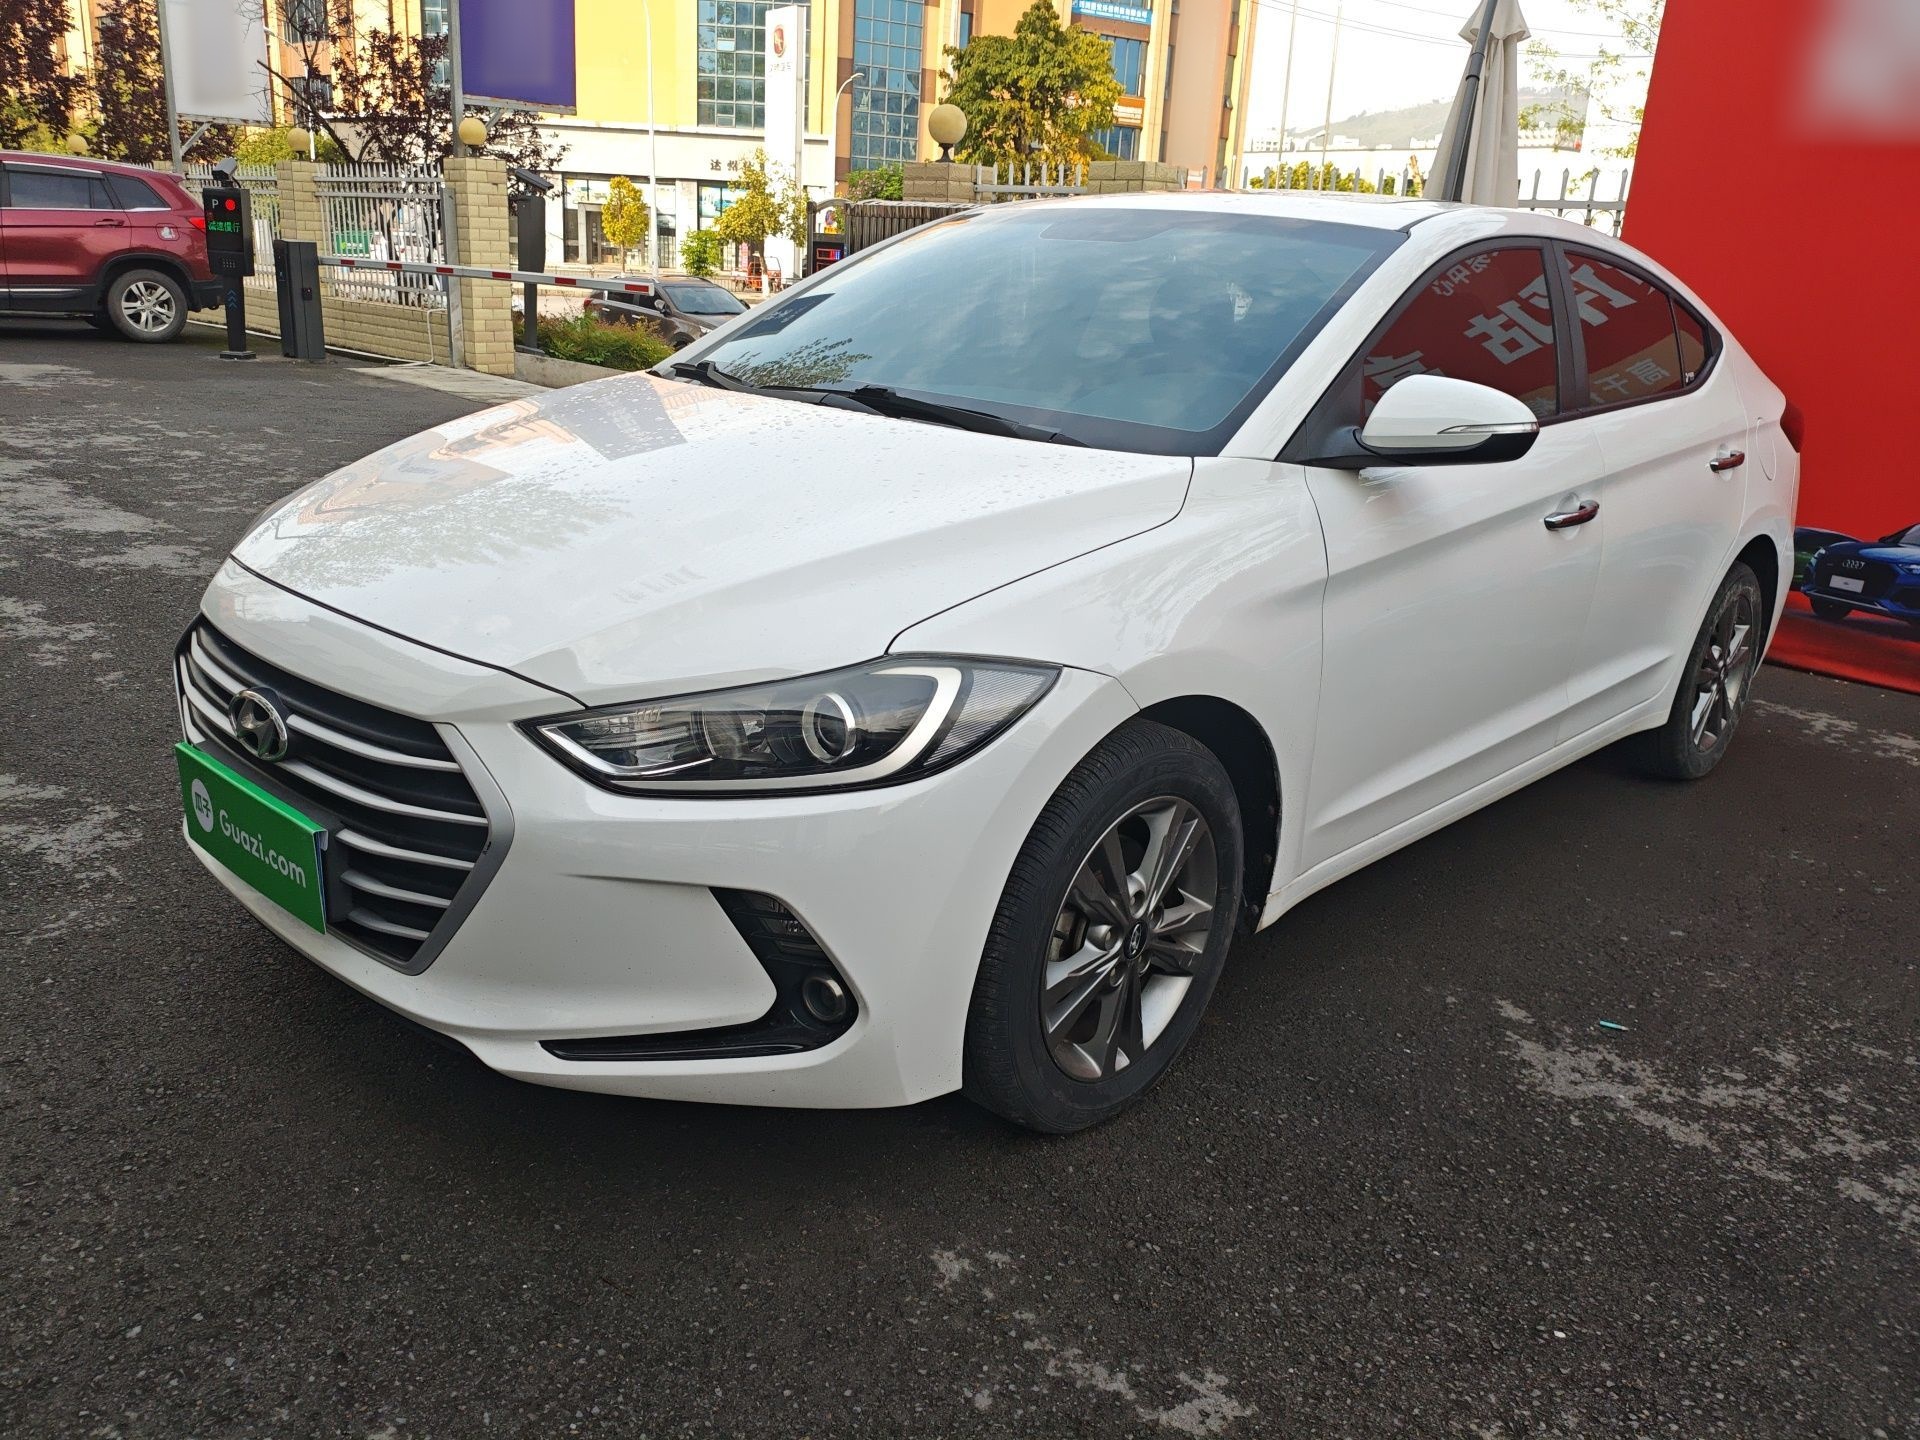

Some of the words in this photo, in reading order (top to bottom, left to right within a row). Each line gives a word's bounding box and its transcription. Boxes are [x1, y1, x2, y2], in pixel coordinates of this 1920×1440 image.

[211, 198, 219, 209] P
[194, 791, 211, 818] 瓜子
[219, 808, 307, 889] Guazi.com
